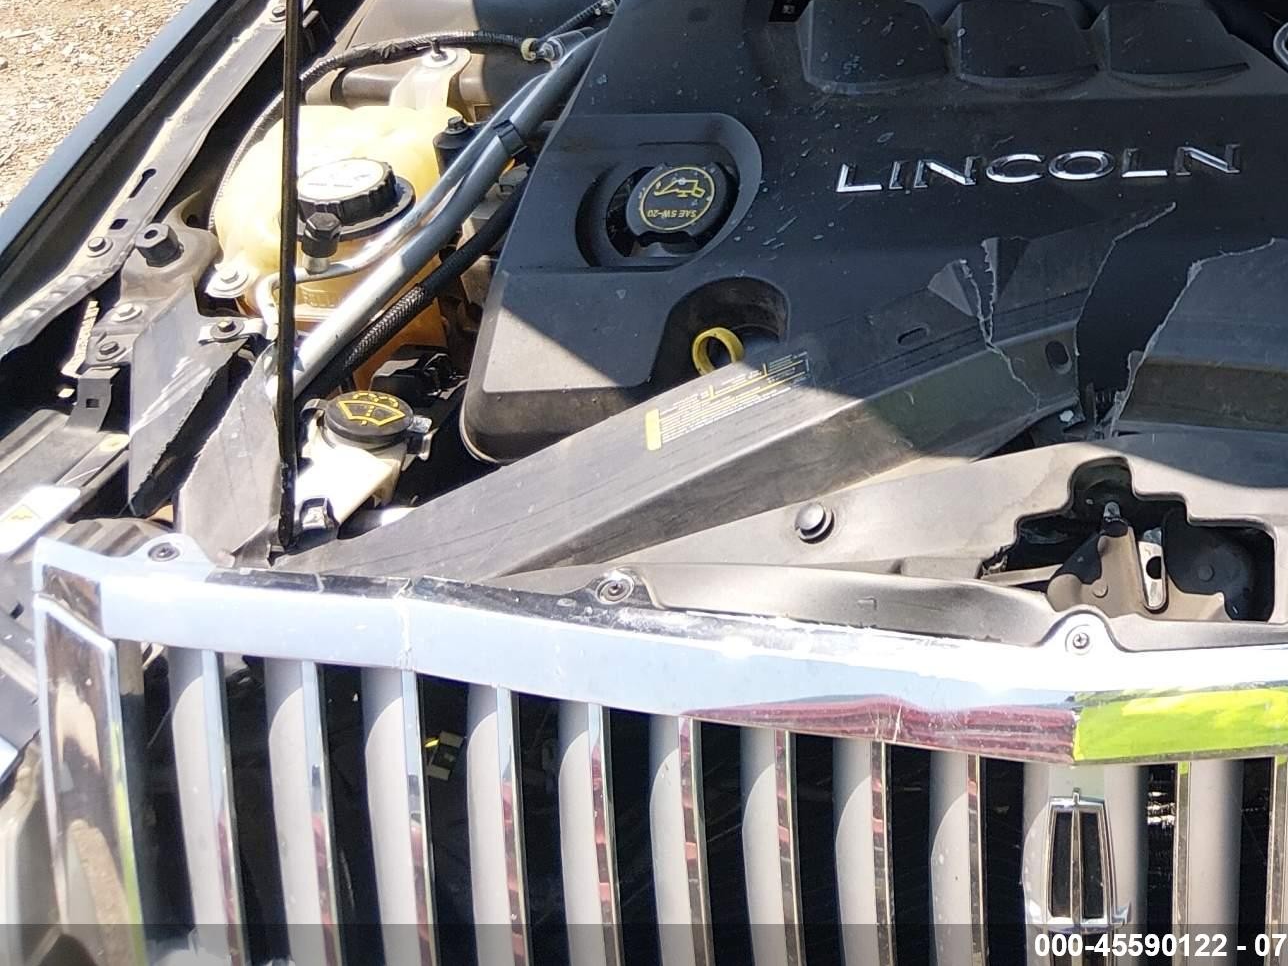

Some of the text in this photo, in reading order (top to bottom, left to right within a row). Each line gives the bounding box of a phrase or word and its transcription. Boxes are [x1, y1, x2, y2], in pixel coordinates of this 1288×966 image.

[836, 143, 1241, 194] LINCOLN
[647, 209, 698, 219] SAE 5W-20
